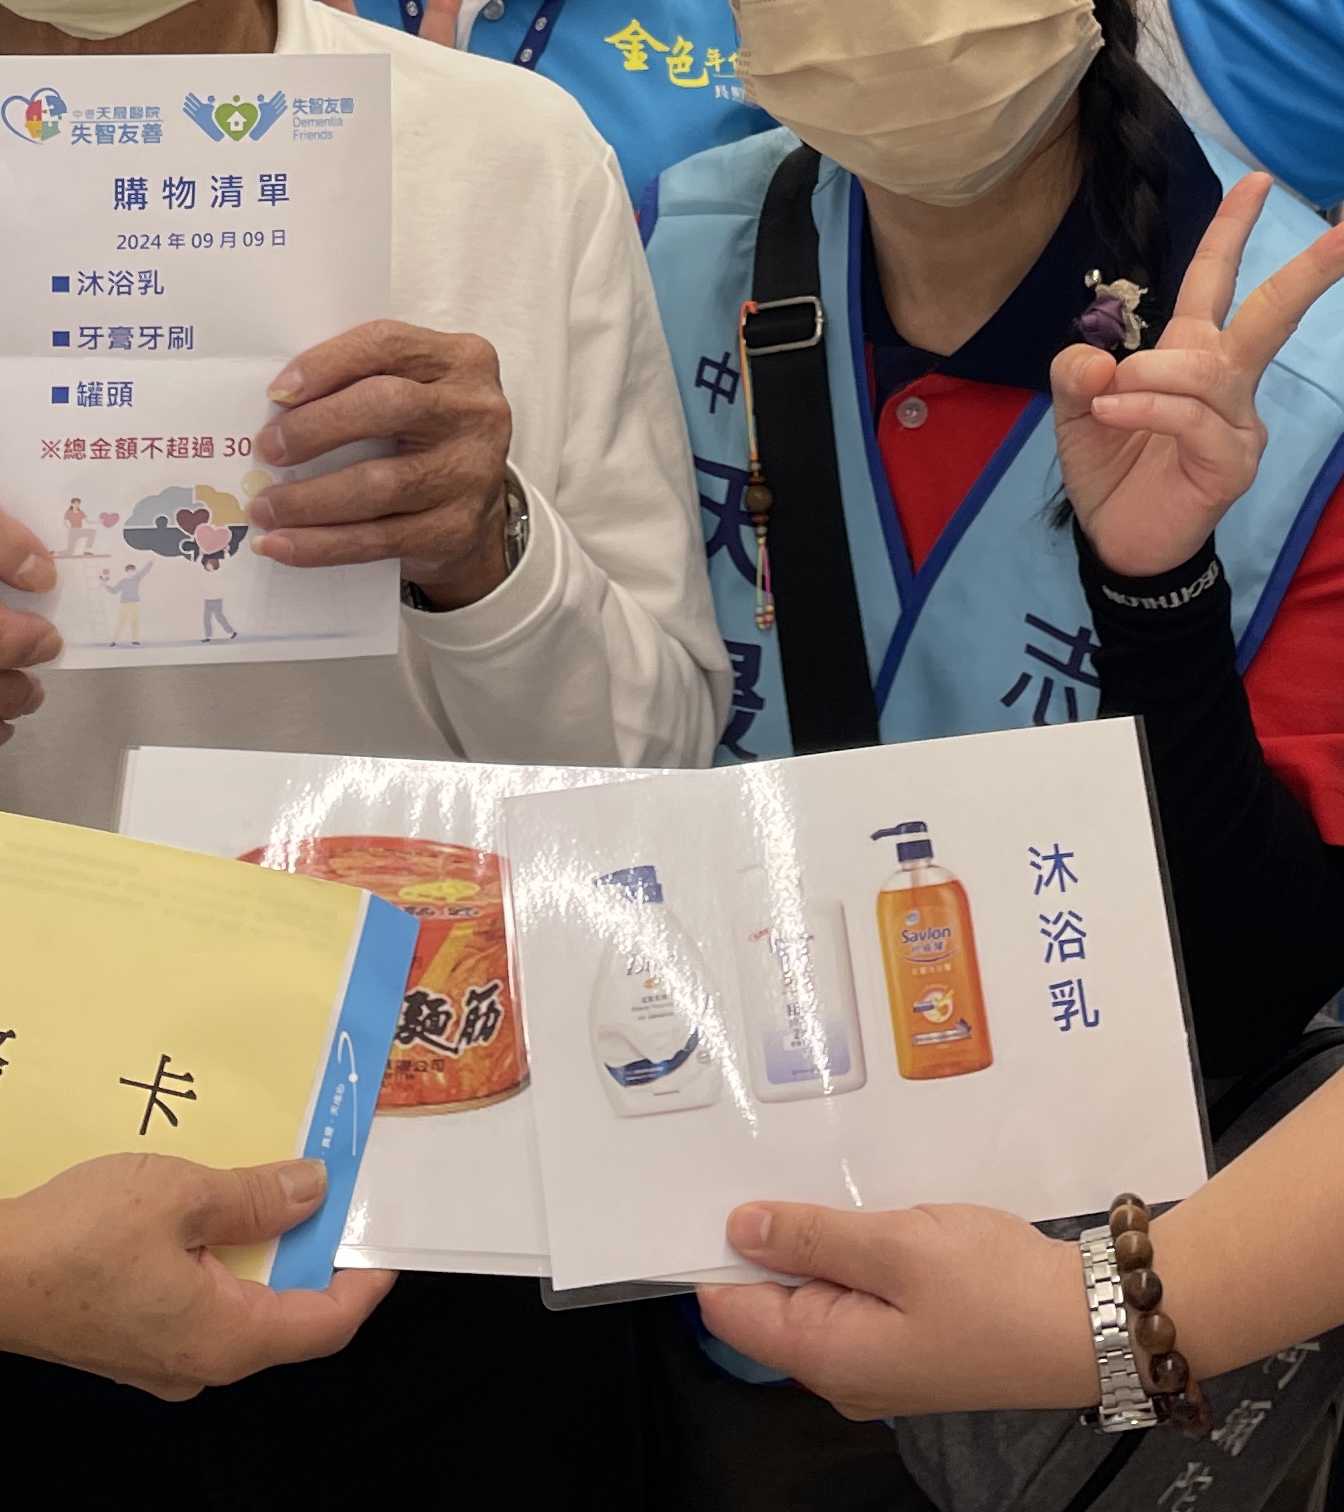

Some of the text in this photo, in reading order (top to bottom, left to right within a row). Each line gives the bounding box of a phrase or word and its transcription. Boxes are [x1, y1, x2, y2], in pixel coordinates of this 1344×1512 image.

[292, 97, 355, 115] 失智友善
[292, 116, 344, 129] Dementia
[70, 123, 164, 146] 失智友善
[292, 129, 334, 141] Friends
[113, 173, 290, 211] 購物清單
[116, 229, 287, 250] 2024 年 09 月 09 日
[77, 270, 165, 296] 沐浴乳
[77, 326, 194, 351] 牙膏牙刷
[76, 381, 135, 408] 罐頭
[900, 926, 951, 945] Savlon
[1027, 842, 1100, 1034] 沐浴乳
